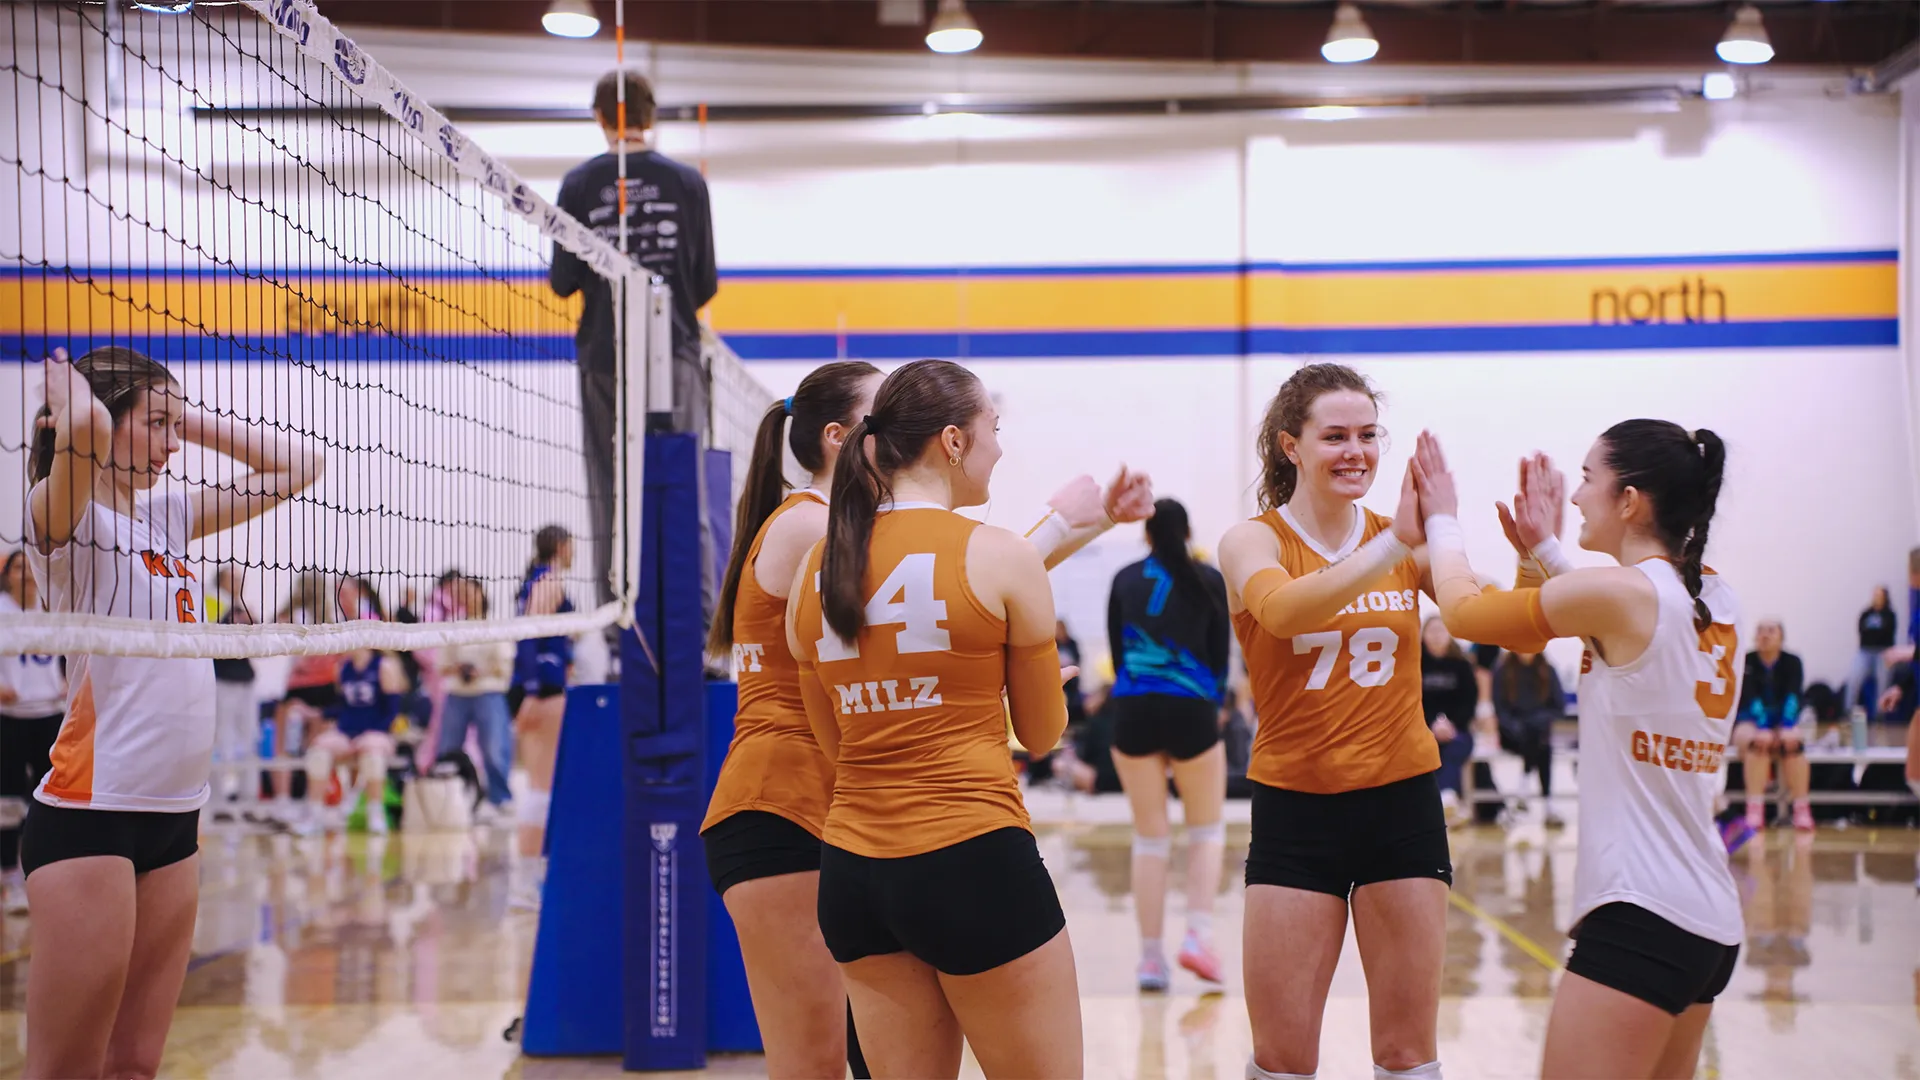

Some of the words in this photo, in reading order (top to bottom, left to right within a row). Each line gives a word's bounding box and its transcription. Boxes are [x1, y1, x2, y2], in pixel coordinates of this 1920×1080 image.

[1591, 276, 1727, 325] north
[175, 587, 197, 623] 6
[1143, 557, 1174, 617] 7
[1291, 626, 1400, 691] 78
[1693, 618, 1738, 720] 3
[834, 675, 943, 715] MILZ
